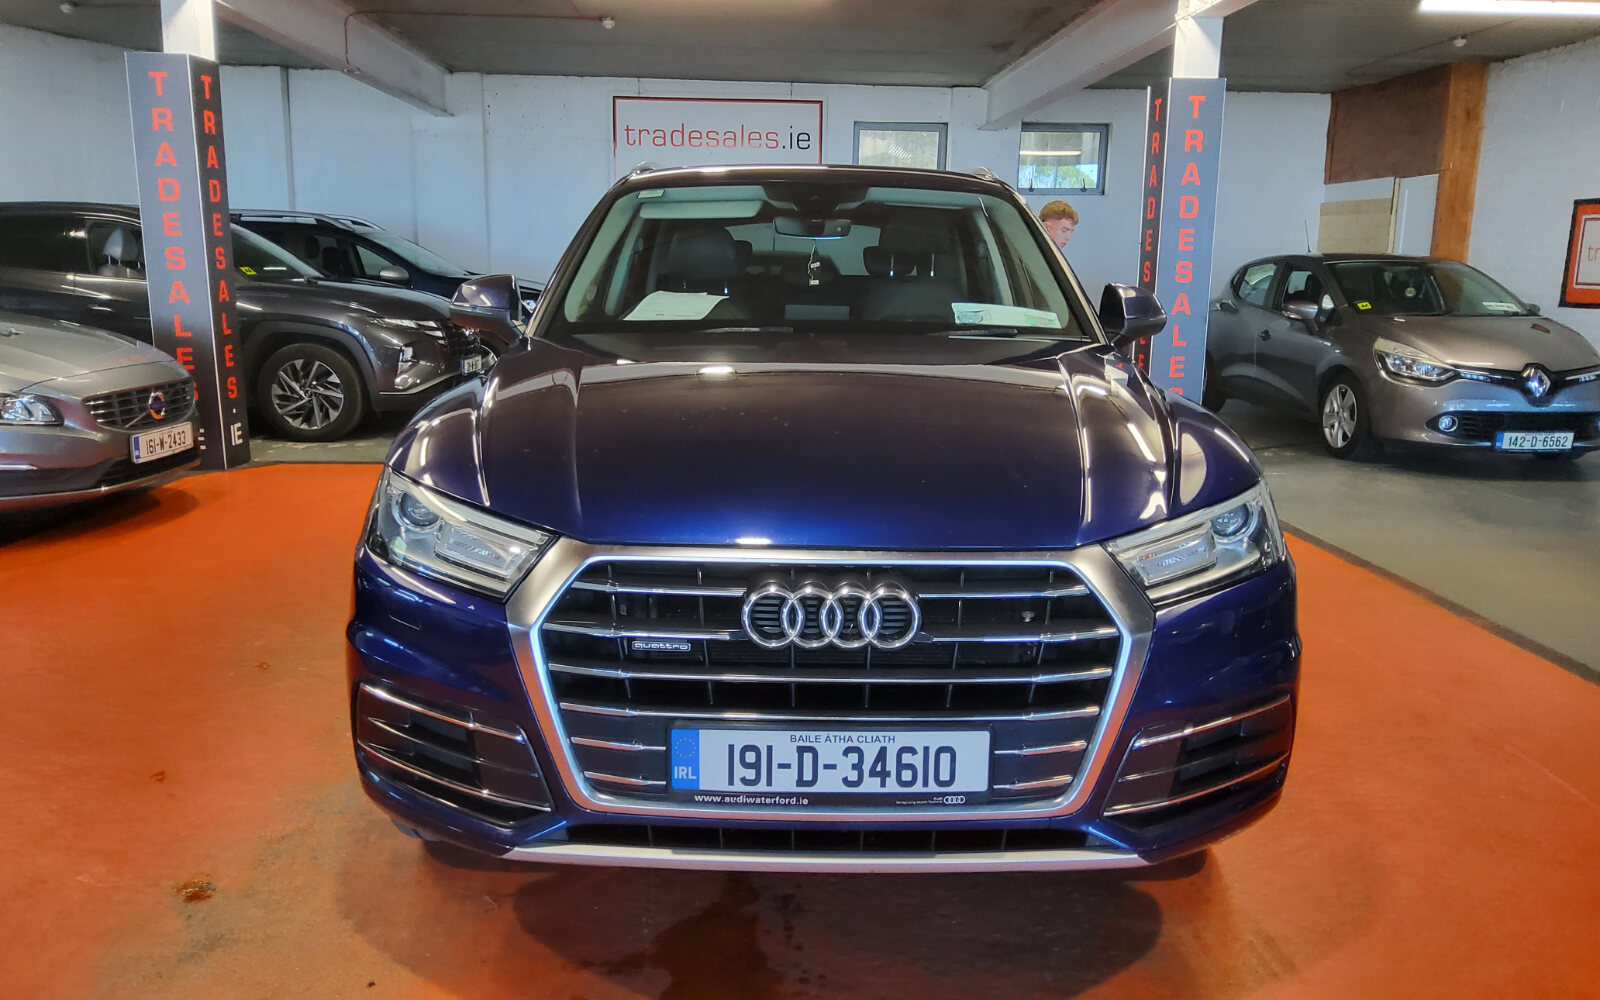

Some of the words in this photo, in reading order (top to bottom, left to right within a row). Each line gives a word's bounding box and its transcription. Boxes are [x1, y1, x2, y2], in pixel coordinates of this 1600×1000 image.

[624, 122, 811, 150] tradesales.ie
[148, 71, 199, 401] TRADESALE
[146, 431, 186, 455] 161-W-2433
[1508, 436, 1569, 448] 142-D-6562
[789, 734, 822, 743] BAILE
[824, 733, 854, 743] ÁTHA
[856, 734, 896, 744] CLIATH
[674, 766, 697, 780] IRL
[727, 743, 957, 788] 191-D-34610
[694, 794, 809, 805] www.audiwaterford.ie
